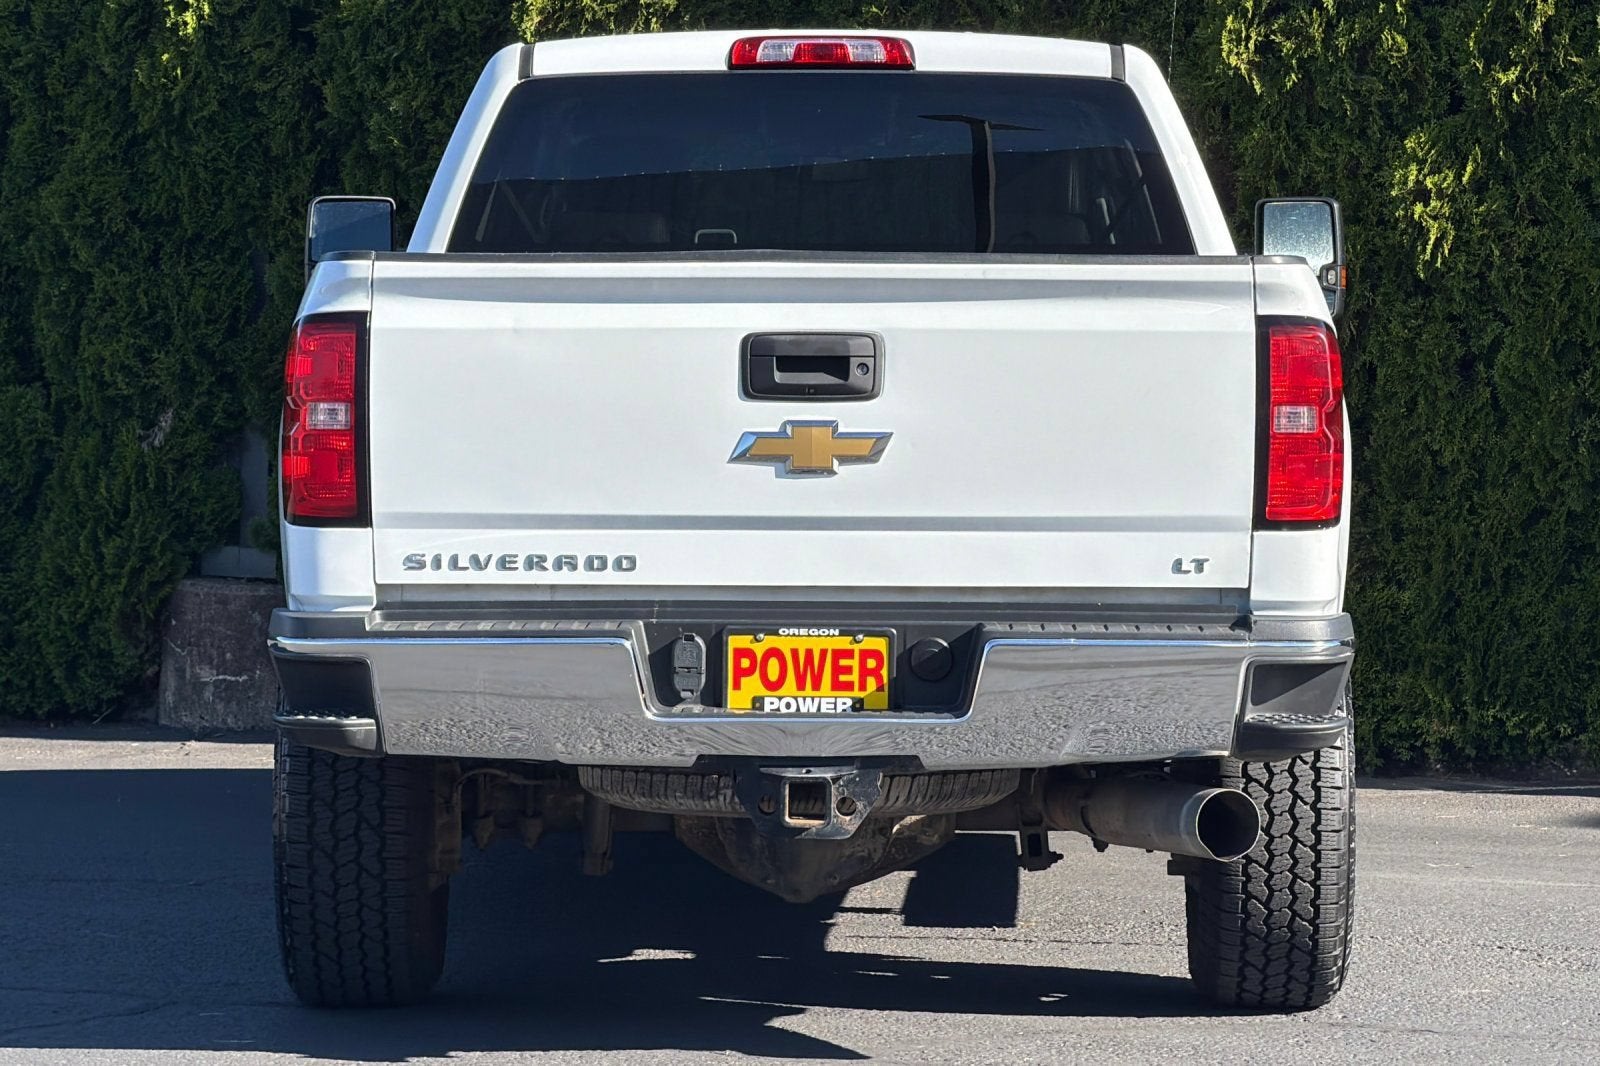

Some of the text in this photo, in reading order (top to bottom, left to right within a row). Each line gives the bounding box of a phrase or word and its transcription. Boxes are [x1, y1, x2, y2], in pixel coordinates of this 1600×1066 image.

[402, 553, 638, 573] SILVERADO
[1171, 557, 1210, 575] LT
[778, 627, 840, 636] OREGON
[731, 647, 885, 693] POWER
[763, 697, 853, 713] POWER
